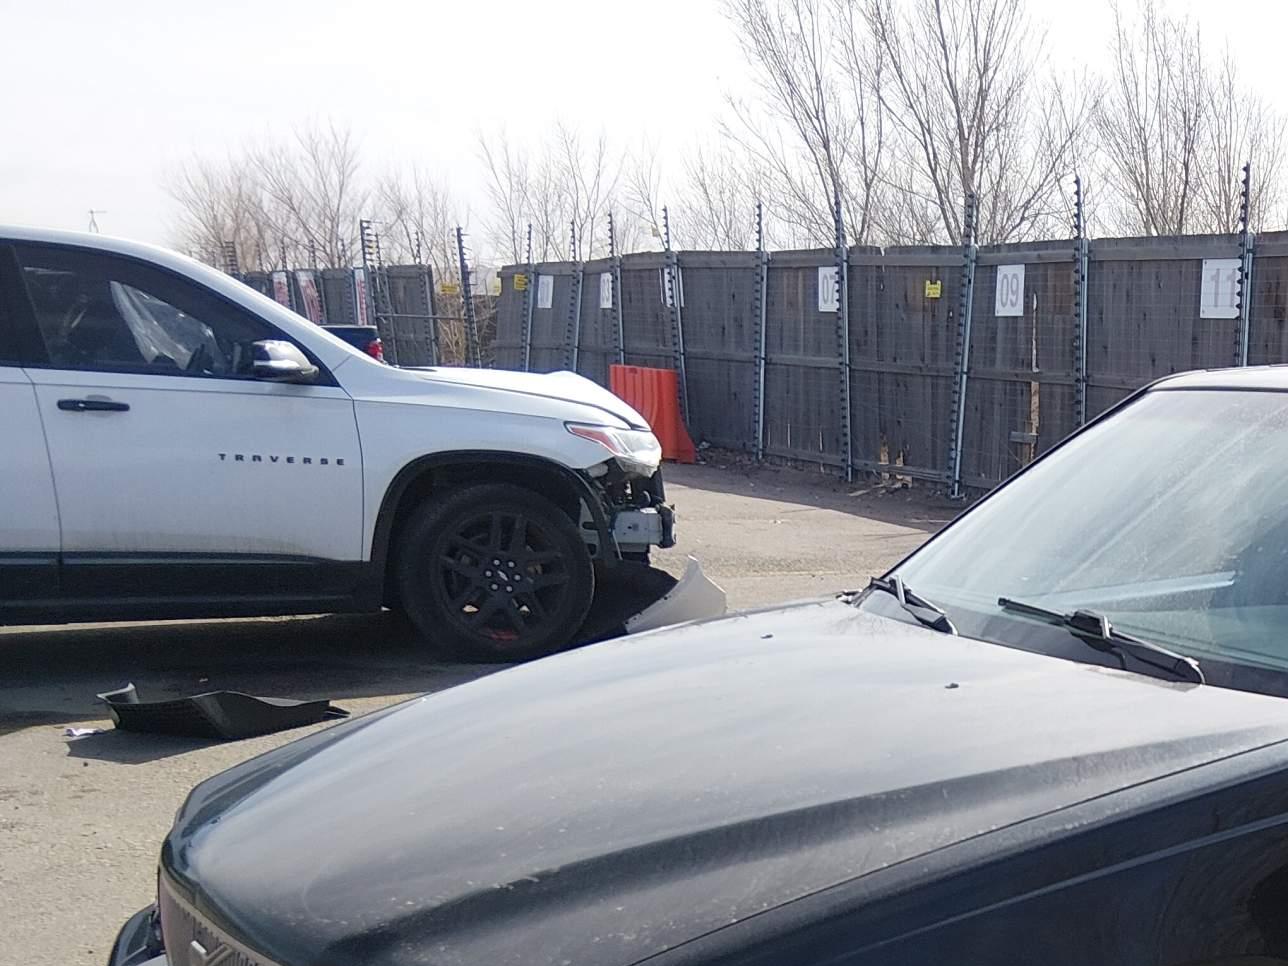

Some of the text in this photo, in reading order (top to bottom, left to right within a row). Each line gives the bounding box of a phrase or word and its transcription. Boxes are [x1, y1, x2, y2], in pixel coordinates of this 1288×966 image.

[1000, 272, 1020, 309] 09
[1210, 267, 1236, 308] 11
[217, 453, 346, 466] TRAVERSE
